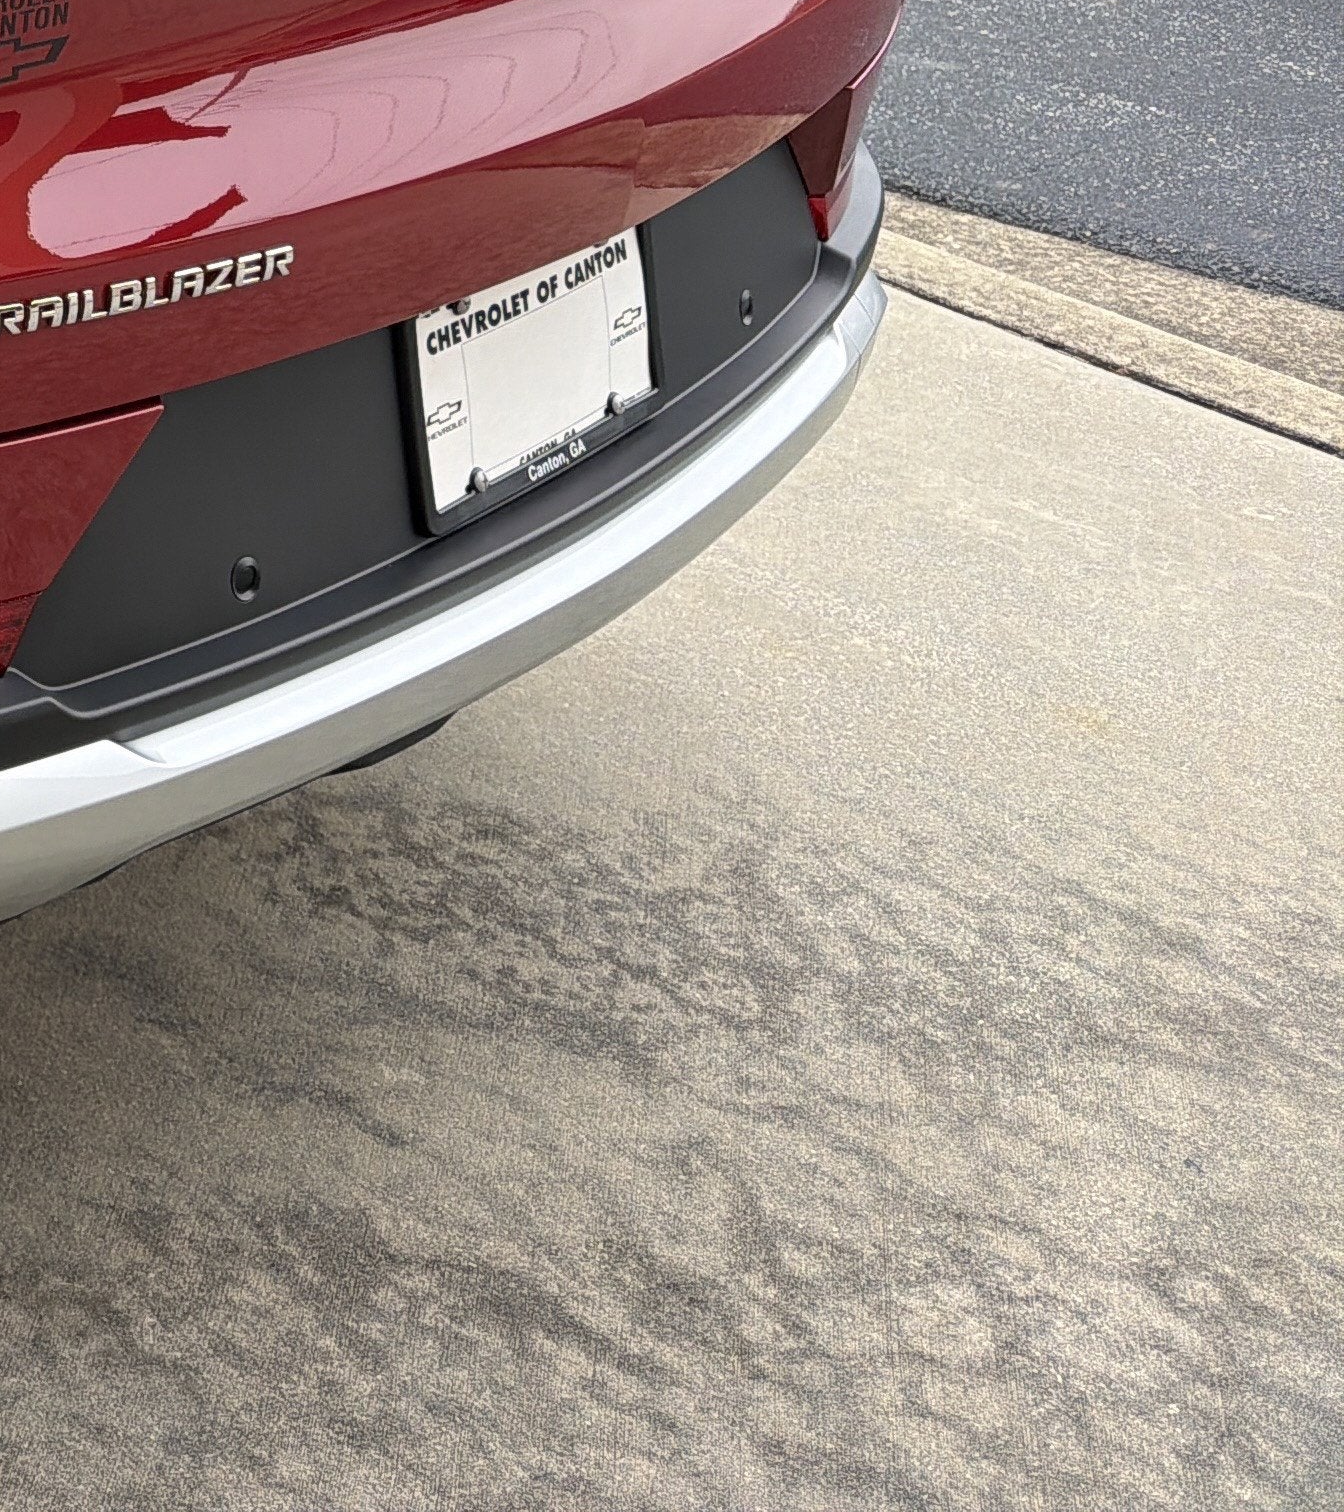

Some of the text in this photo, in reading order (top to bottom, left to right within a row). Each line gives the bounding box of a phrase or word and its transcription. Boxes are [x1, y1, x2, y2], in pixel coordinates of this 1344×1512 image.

[425, 238, 628, 355] CHEVROLET OF CANTON
[527, 438, 587, 481] Canton, GA
